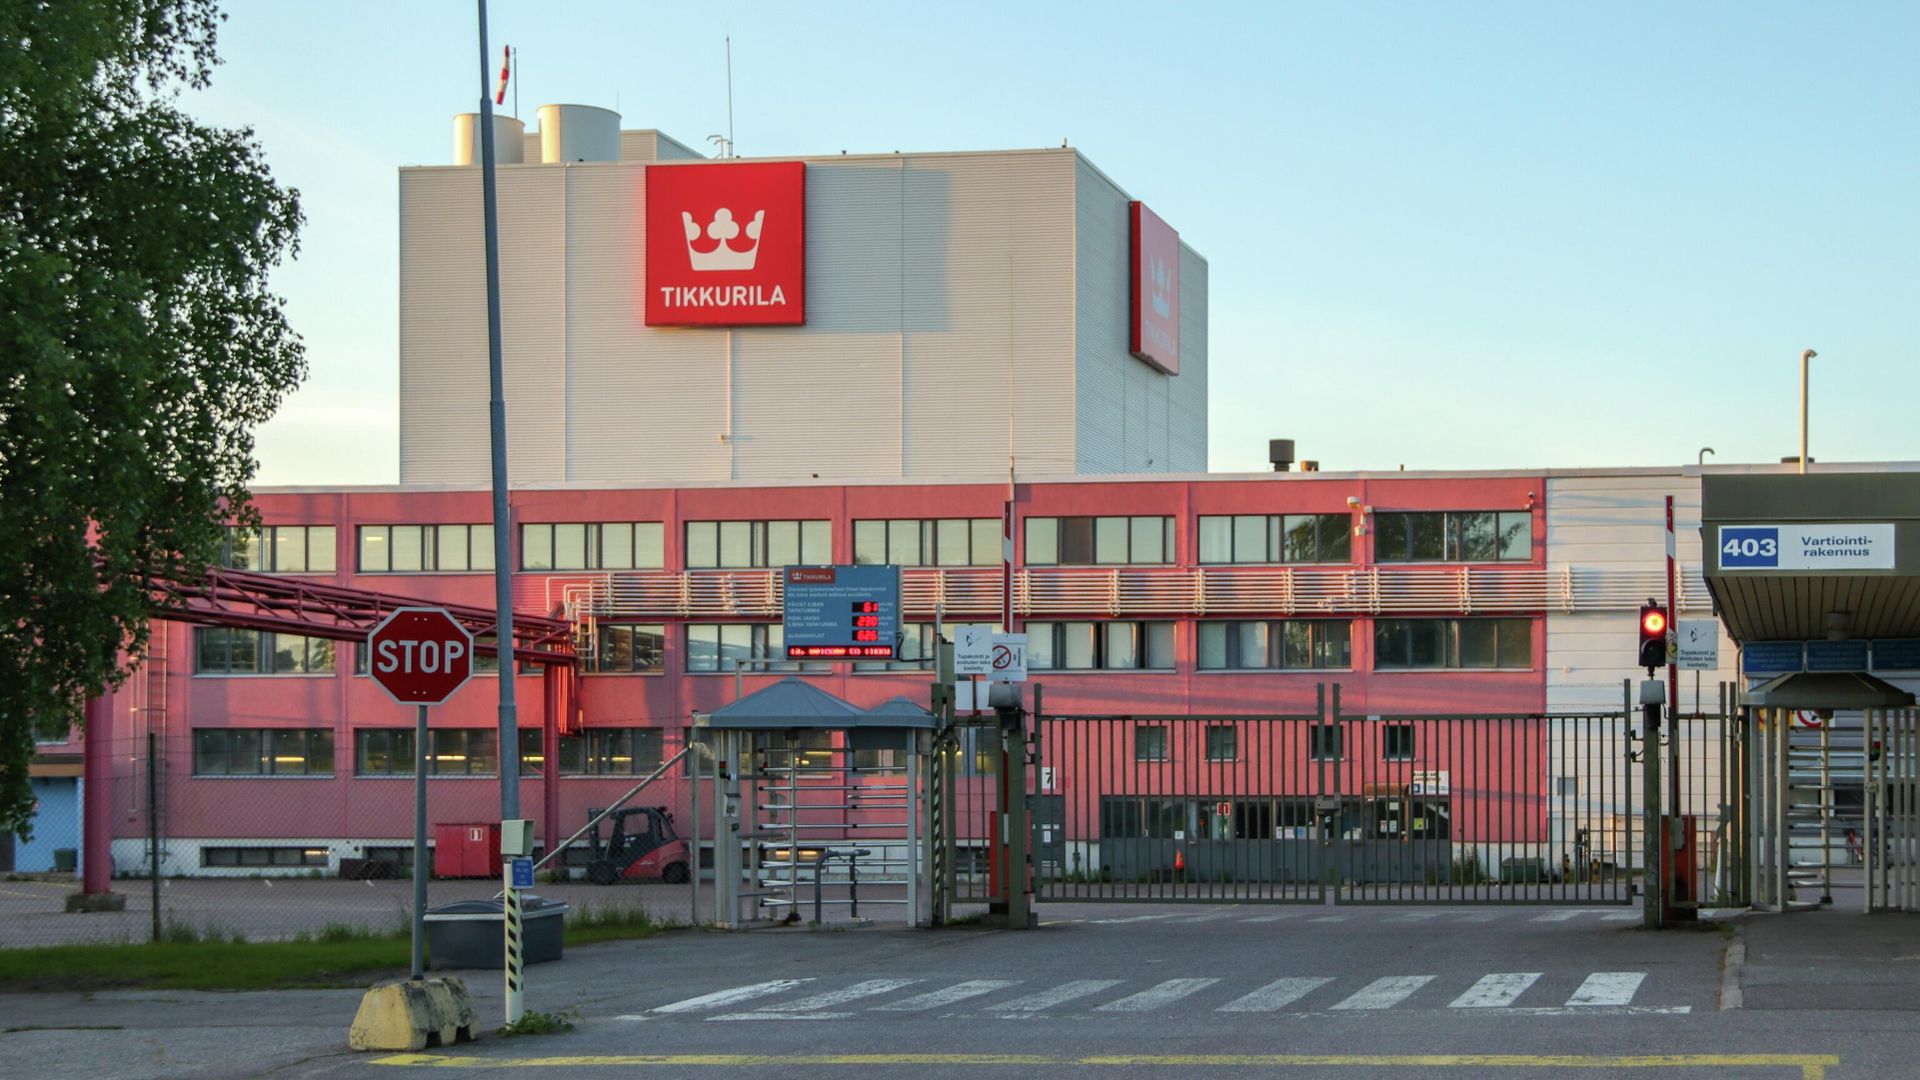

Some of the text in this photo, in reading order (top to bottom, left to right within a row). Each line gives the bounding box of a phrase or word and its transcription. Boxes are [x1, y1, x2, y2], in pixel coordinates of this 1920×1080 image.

[661, 285, 786, 307] TIKKURILA
[1722, 538, 1777, 557] 403
[1801, 536, 1873, 546] Vartiointi-
[1803, 547, 1870, 557] rakennus
[378, 640, 464, 673] STOP
